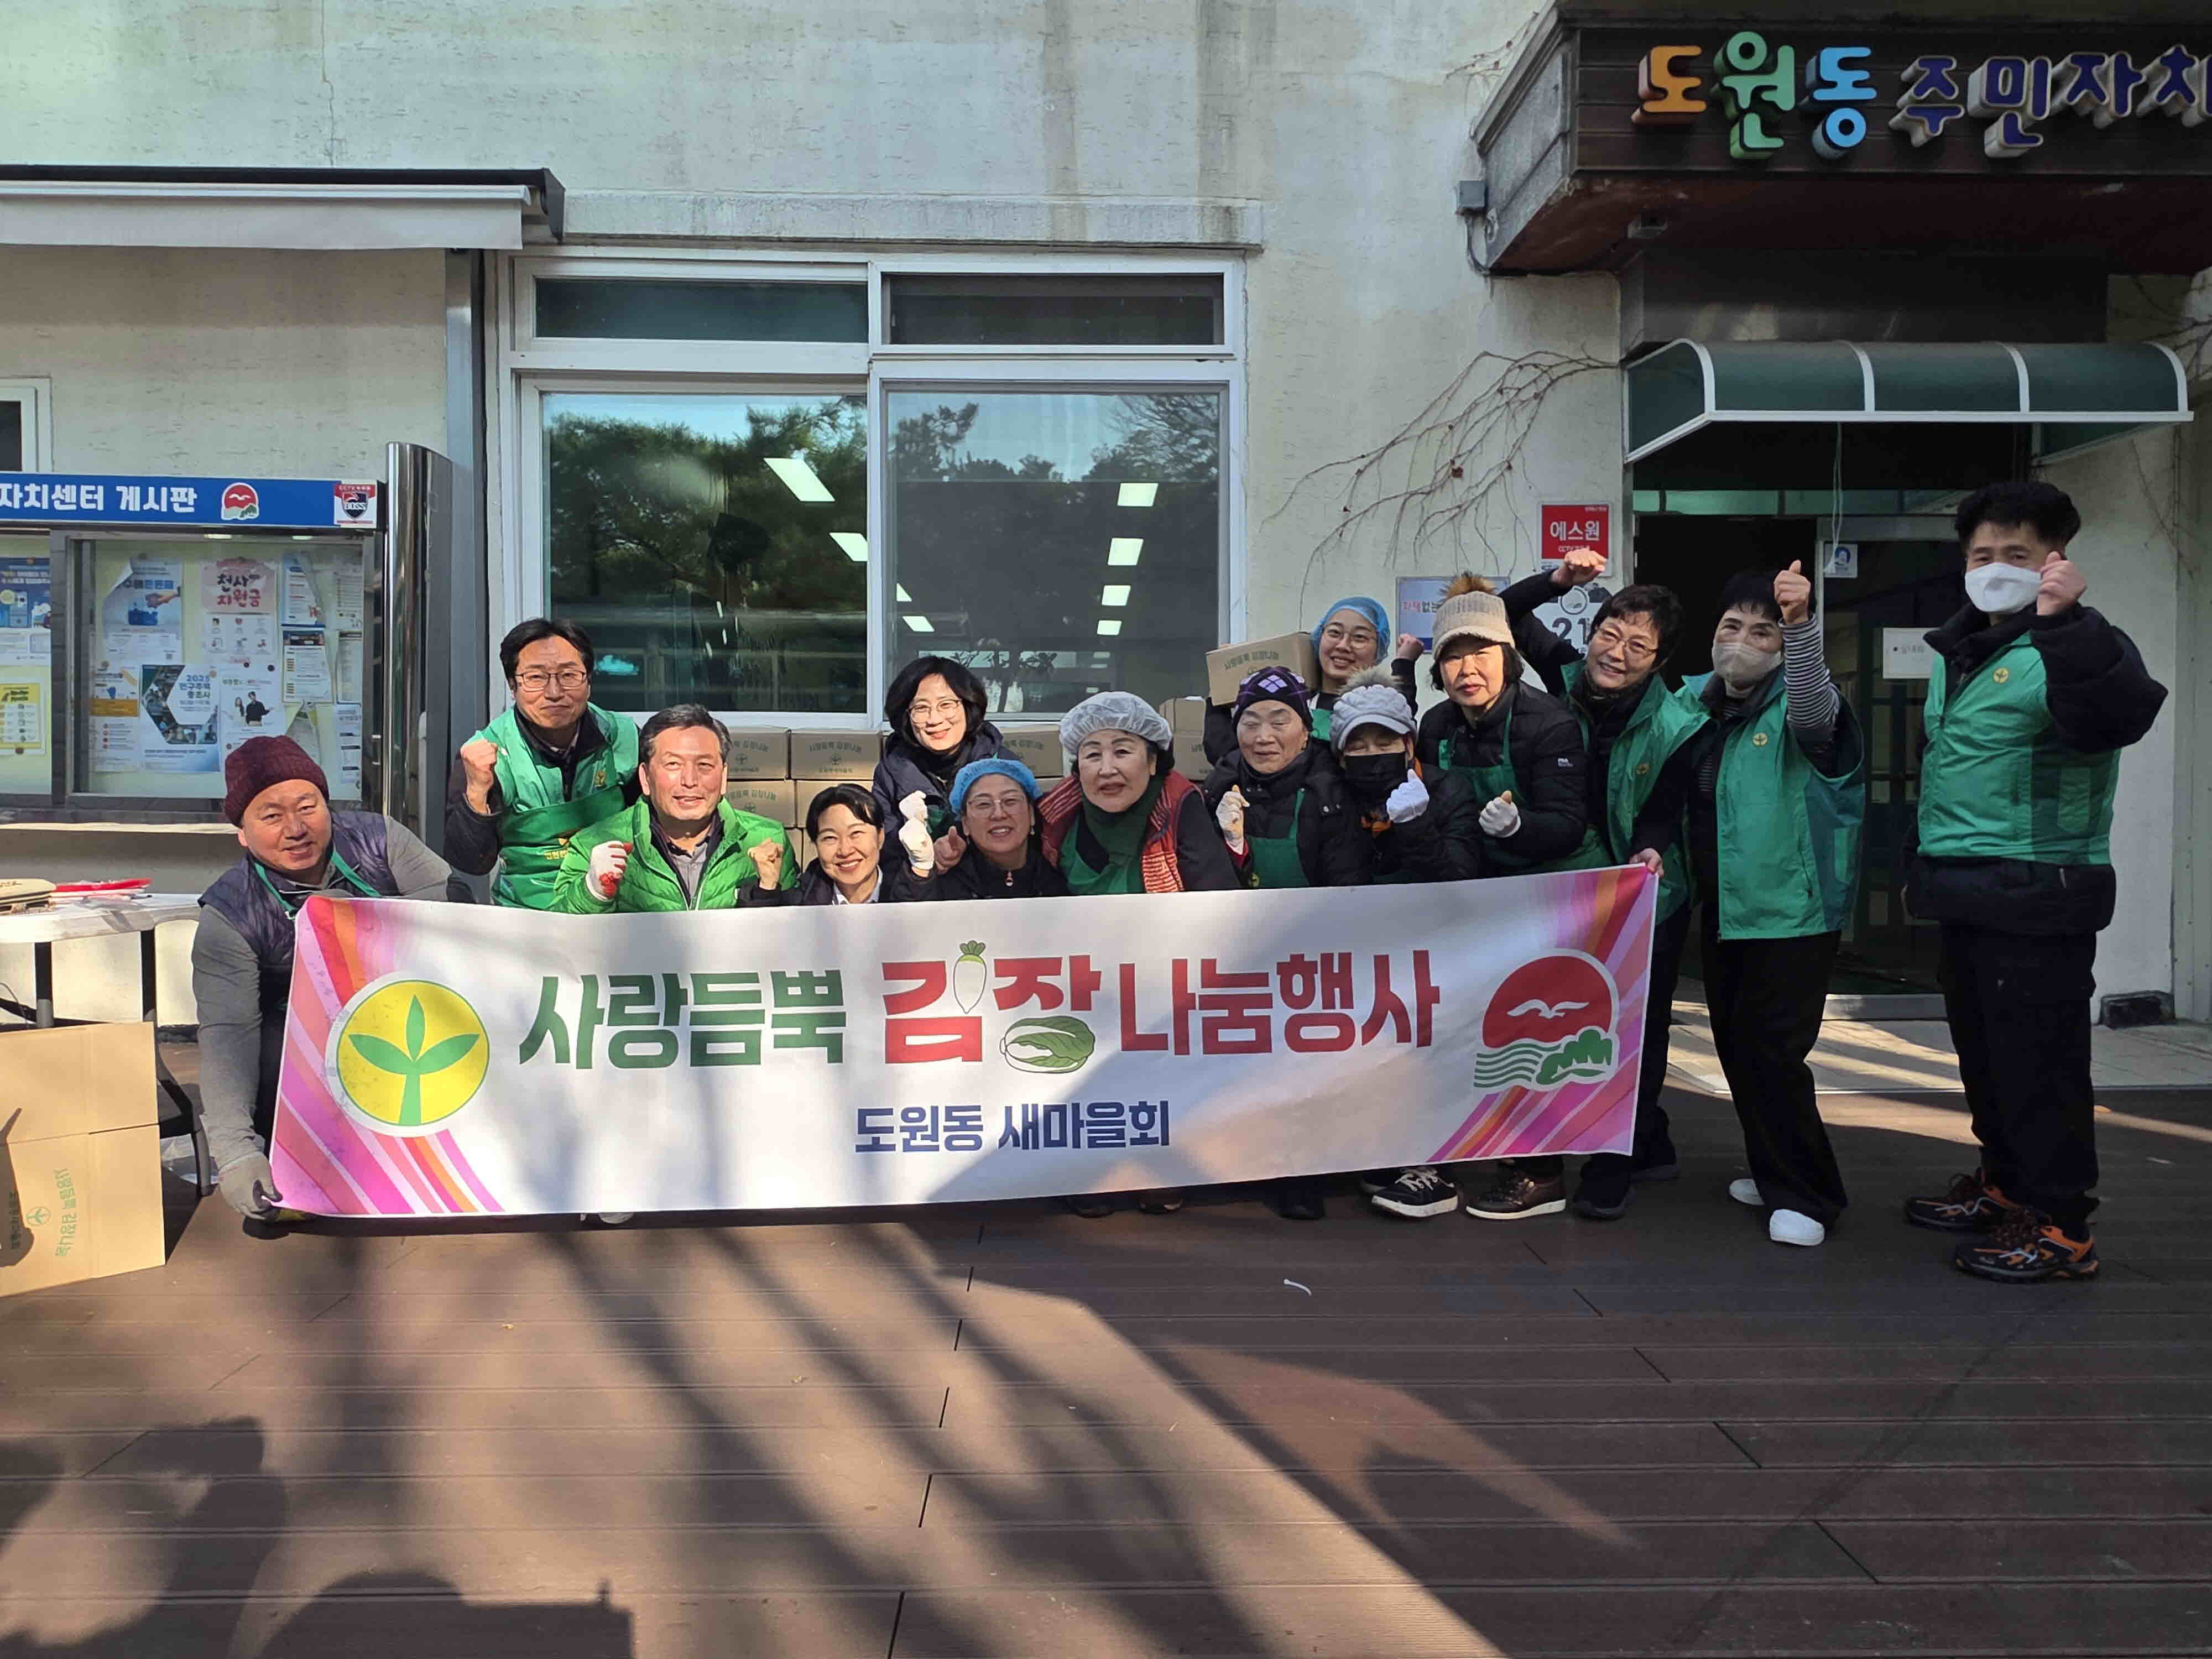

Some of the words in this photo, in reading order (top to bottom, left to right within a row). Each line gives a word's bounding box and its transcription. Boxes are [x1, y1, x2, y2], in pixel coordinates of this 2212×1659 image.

[1632, 32, 1877, 159] 도원동
[1888, 44, 2212, 157] 주민자치
[0, 483, 104, 511] 자치센터
[116, 486, 197, 513] 게시판
[1550, 521, 1600, 541] 에스원
[216, 588, 261, 607] 지원금
[519, 969, 847, 1069] 사랑듬뿍
[883, 940, 1102, 1074] 김장
[854, 1105, 984, 1154] 도원동
[997, 1100, 1171, 1150] 새마을회
